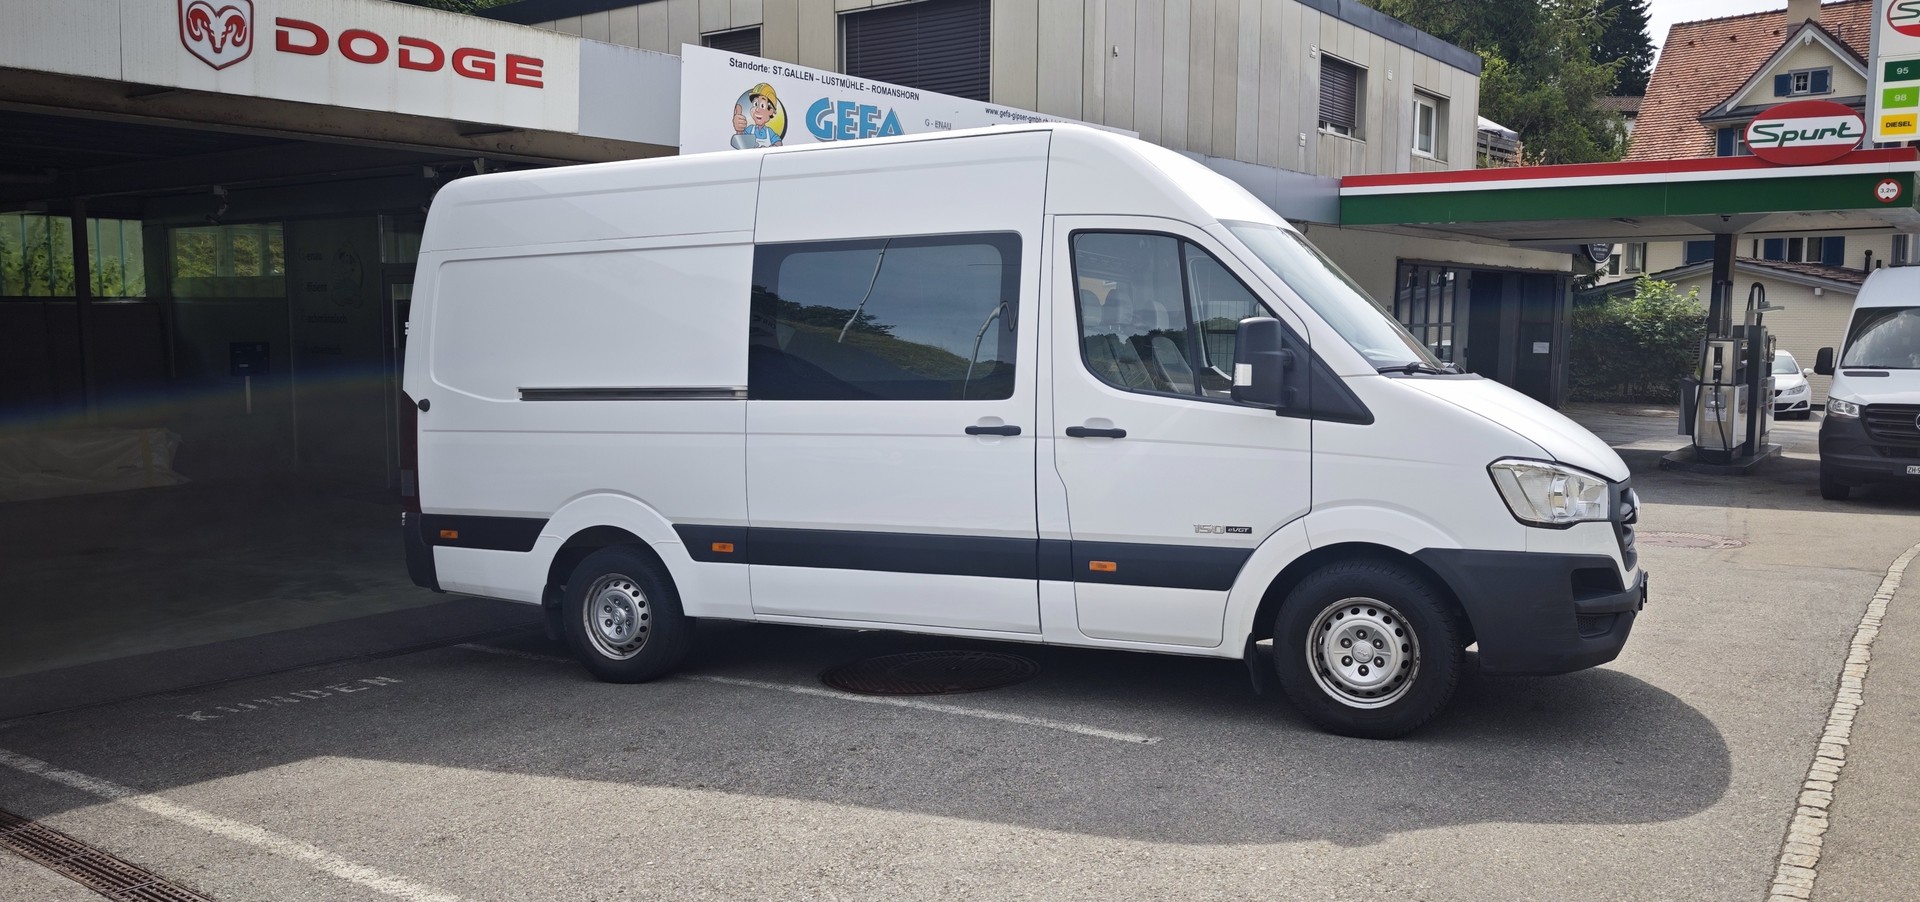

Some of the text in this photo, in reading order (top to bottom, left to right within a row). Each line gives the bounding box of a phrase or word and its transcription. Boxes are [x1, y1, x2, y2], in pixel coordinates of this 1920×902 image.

[276, 16, 544, 89] DODGE
[729, 57, 770, 74] Standorte:
[772, 65, 814, 82] ST.GALLEN
[821, 77, 864, 92] LUSTMÜHLE
[871, 84, 920, 101] ROMANSHORN
[1896, 66, 1909, 75] 95
[1894, 93, 1907, 102] 98
[805, 97, 905, 142] GEFA
[985, 107, 1048, 123] www.gefa-gipser-gmbhch
[1885, 120, 1913, 128] DIESEL
[1748, 121, 1862, 148] Spurt
[1193, 524, 1226, 535] 150
[176, 676, 403, 721] KUNDEN
